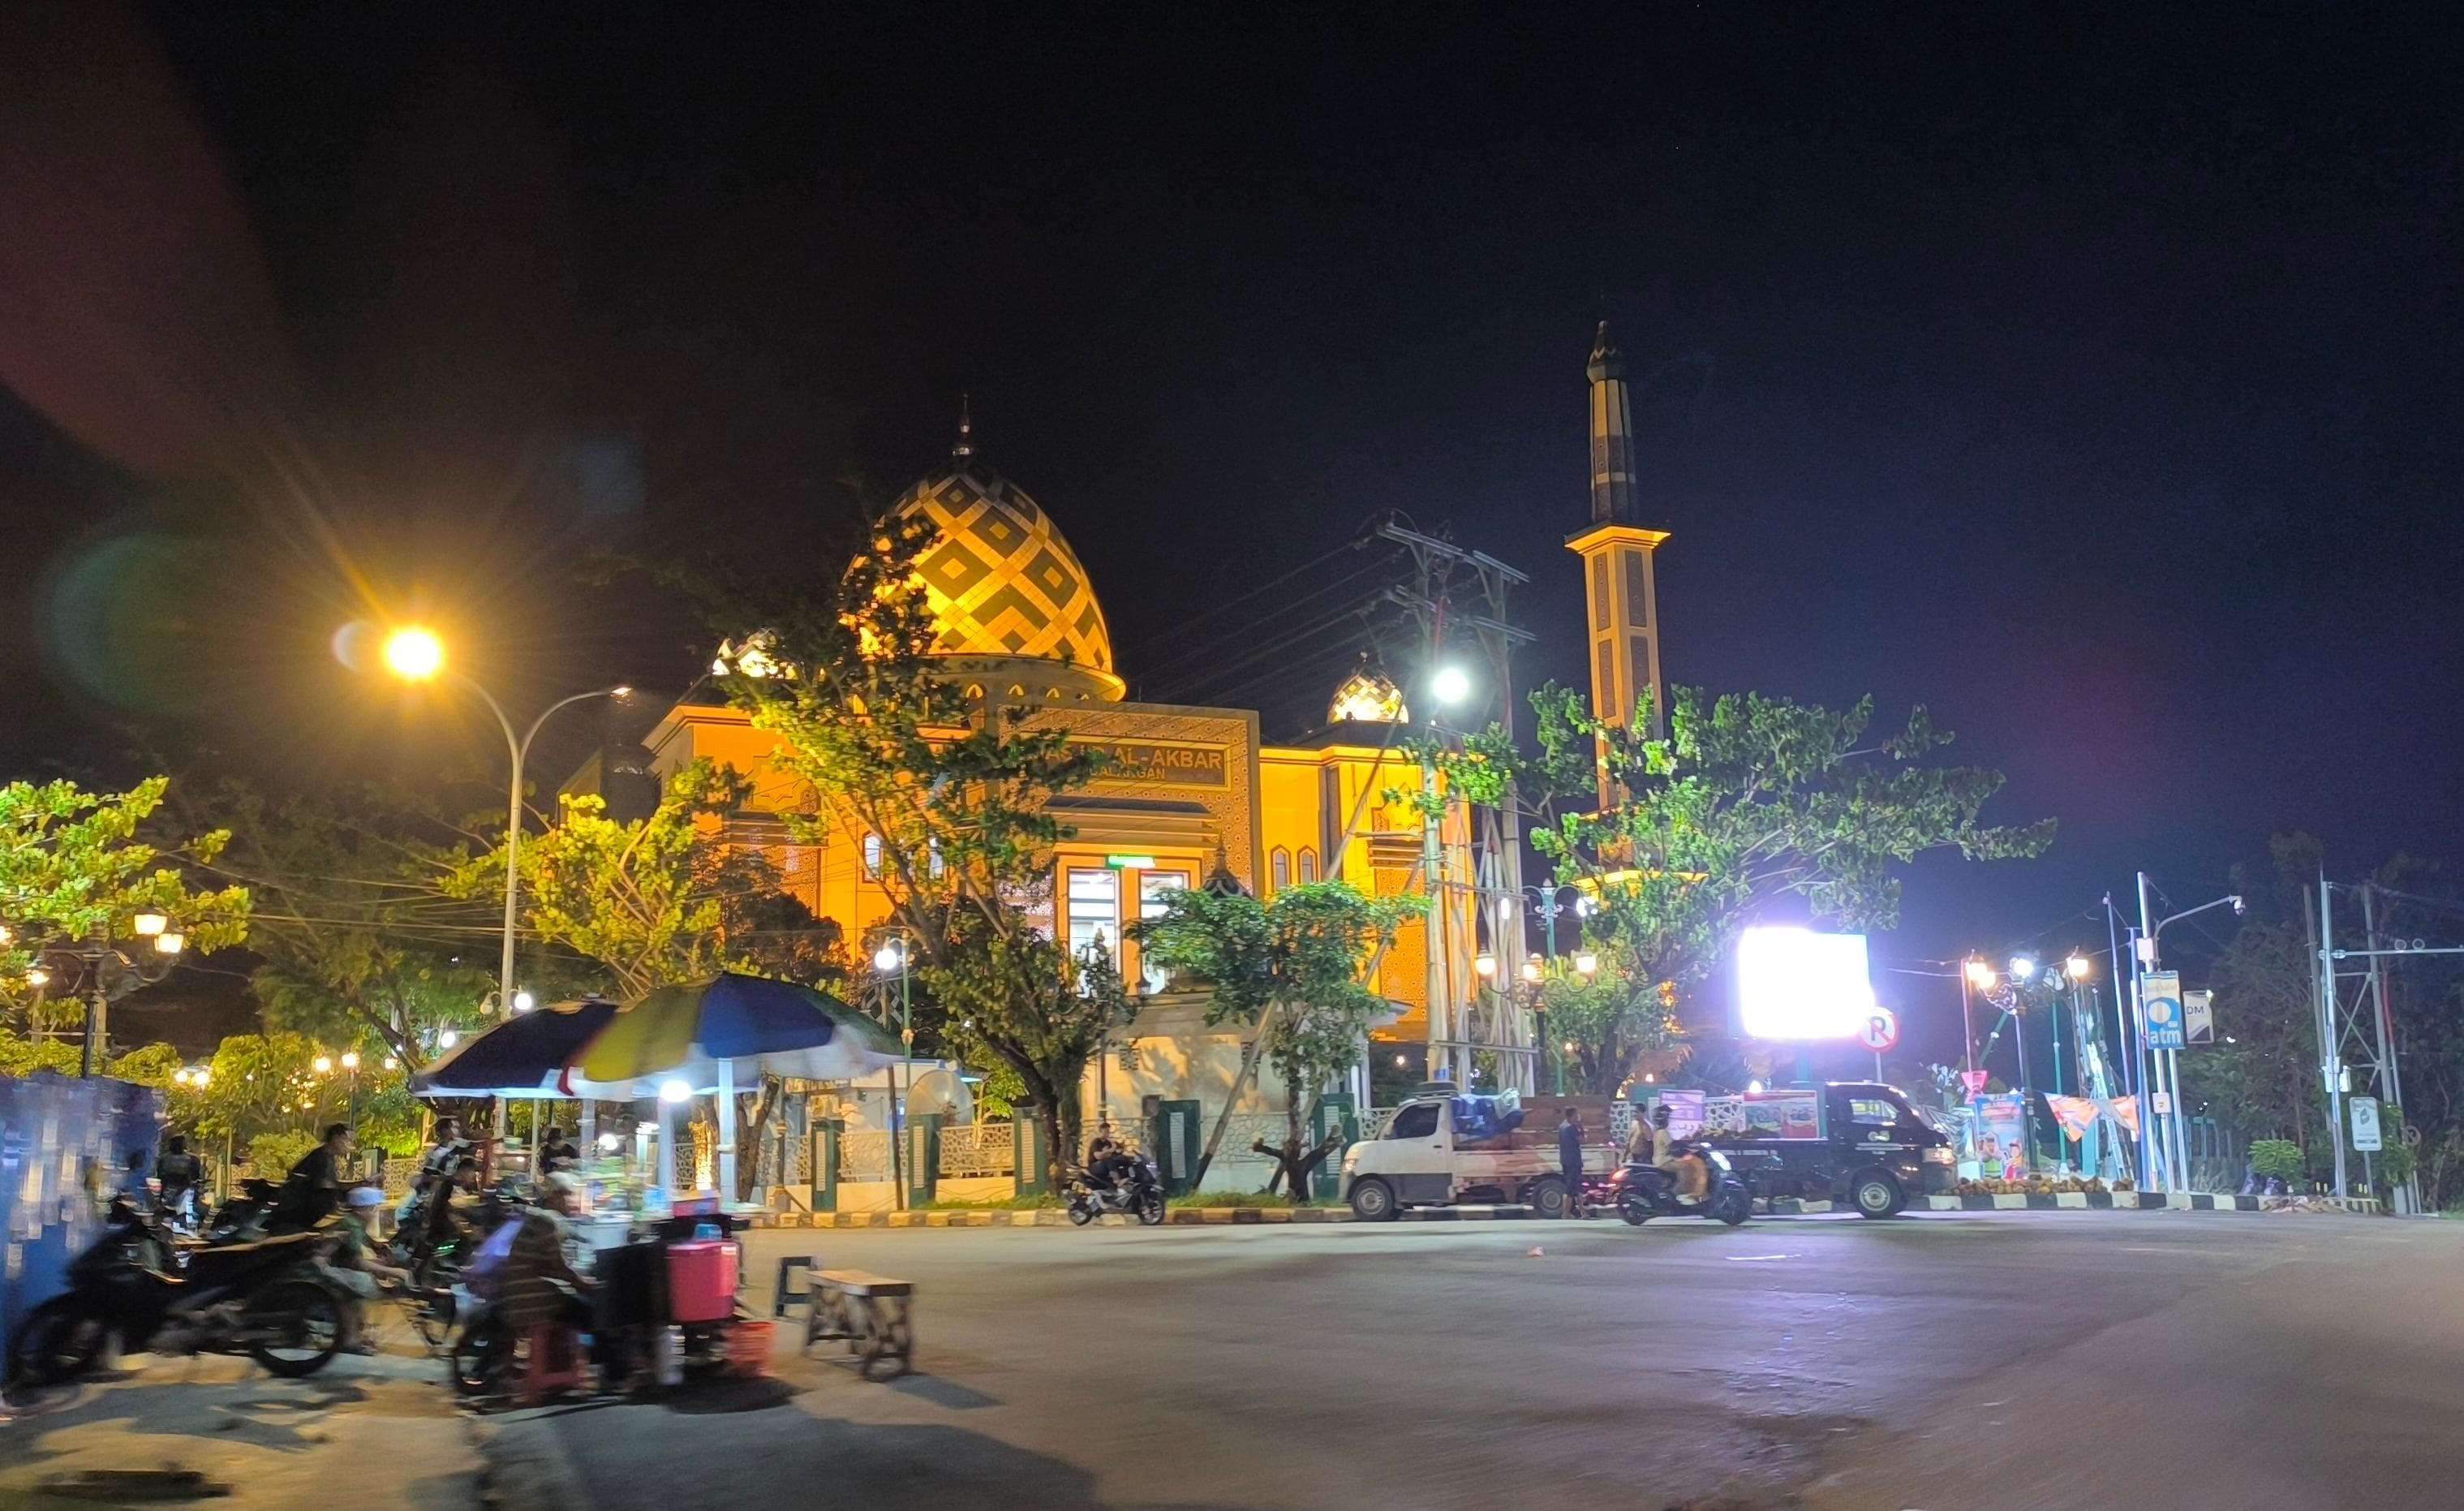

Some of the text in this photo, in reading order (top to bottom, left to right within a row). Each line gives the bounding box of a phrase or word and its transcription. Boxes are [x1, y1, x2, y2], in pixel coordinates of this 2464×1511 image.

[1115, 747, 1222, 769] AL-AKBAR
[1870, 1016, 1886, 1042] P
[2150, 1027, 2182, 1044] atm
